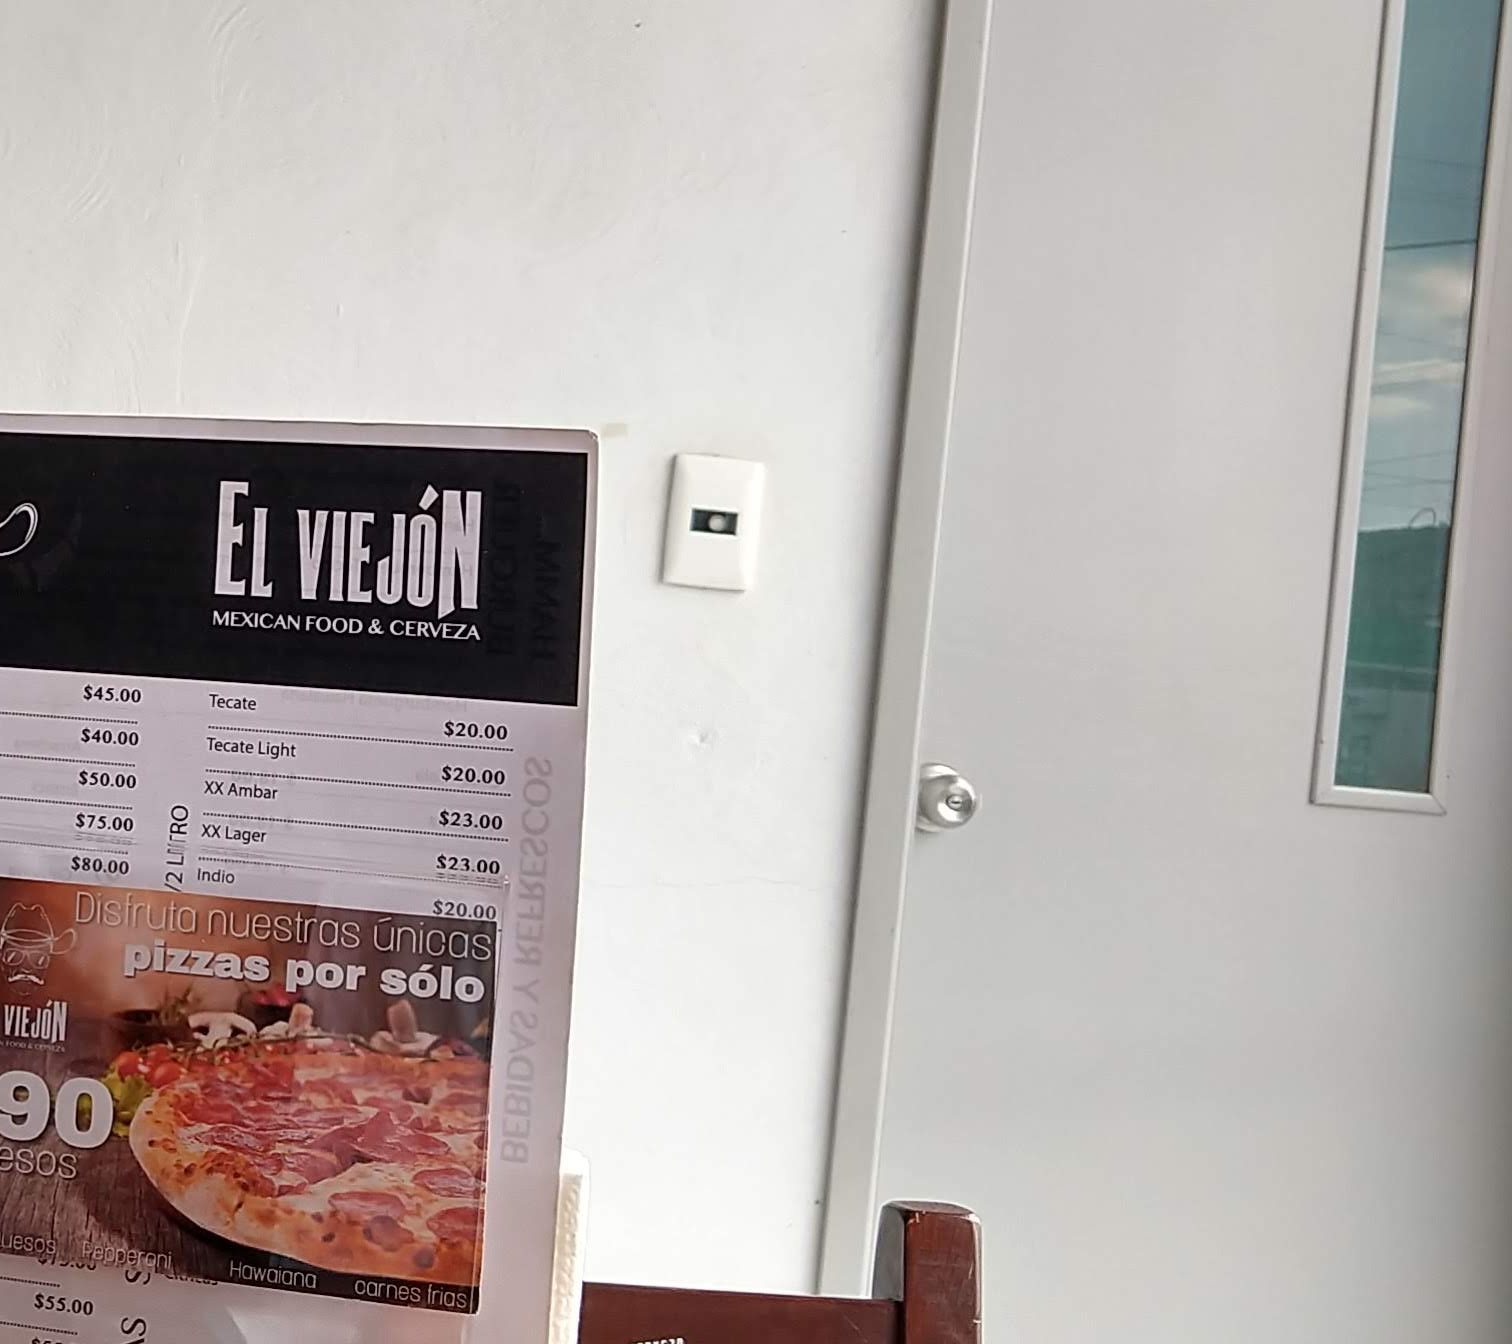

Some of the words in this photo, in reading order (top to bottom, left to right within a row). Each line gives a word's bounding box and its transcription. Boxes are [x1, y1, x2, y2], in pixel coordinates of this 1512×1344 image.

[214, 479, 273, 598] EL
[296, 484, 483, 619] VIEJÓN
[212, 610, 300, 631] MEXICAN
[305, 615, 363, 635] FOOD
[367, 618, 385, 635] &
[389, 619, 482, 641] CERVEZA
[82, 683, 142, 704] $45.00
[208, 693, 257, 712] Tecate
[80, 727, 140, 747] $40.00
[443, 720, 509, 741] $20.00
[206, 736, 255, 755] Tecate
[257, 740, 297, 761] Light
[77, 769, 137, 790] $50.00
[440, 764, 506, 787] $20.00
[203, 780, 225, 796] XX
[227, 782, 279, 803] Ambar
[74, 812, 134, 833] $75.00
[438, 809, 504, 832] $23.00
[200, 823, 222, 838] XX
[224, 825, 268, 847] Lager
[70, 855, 130, 876] $80.00
[196, 867, 236, 885] Indio
[435, 853, 501, 877] $23.00
[431, 899, 498, 922] $20.00
[74, 889, 199, 936] Disfruta
[206, 910, 362, 950] nuestras
[372, 917, 492, 963] únicas
[122, 940, 271, 983] pizzas
[285, 958, 367, 993] por
[379, 962, 486, 1004] sólo
[81, 1240, 173, 1270] Pepperoni
[228, 1259, 318, 1291] Hawaiana
[354, 1279, 422, 1305] carnes
[33, 1292, 94, 1316] $55.00
